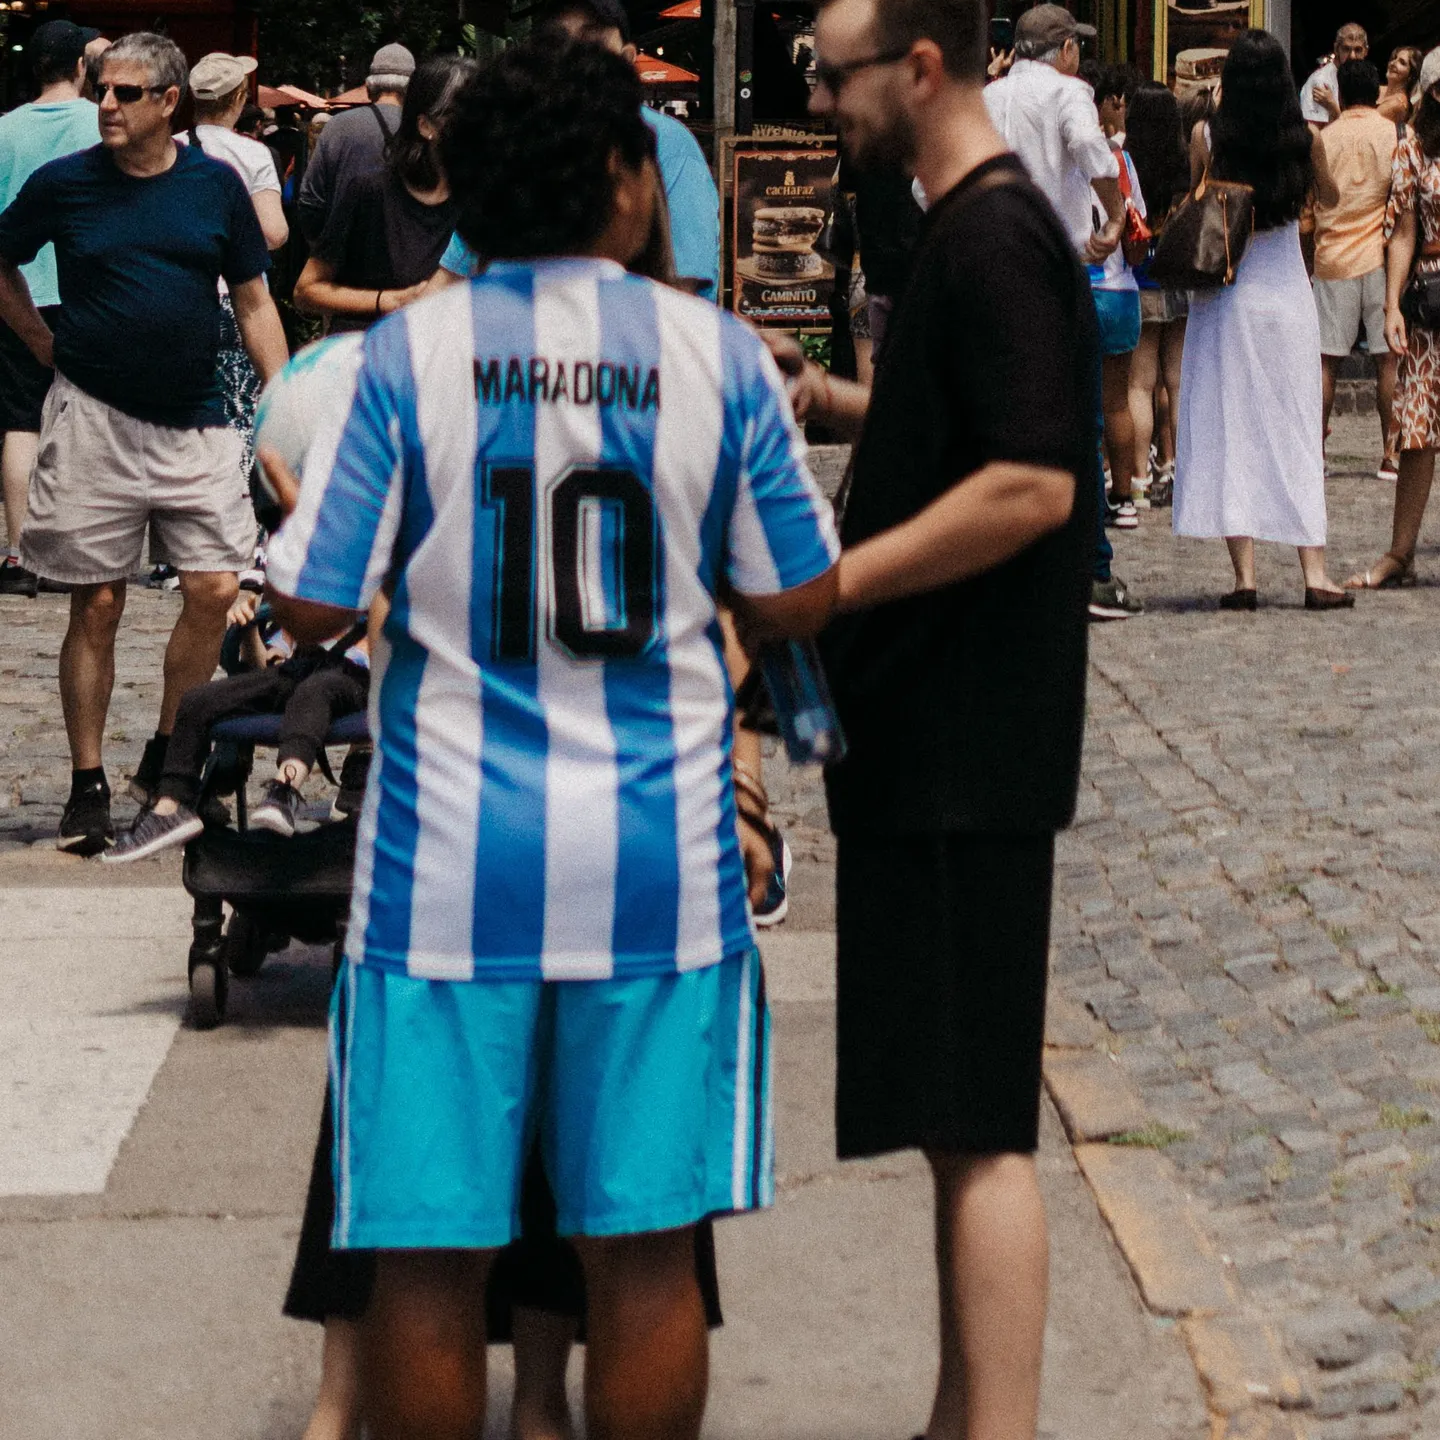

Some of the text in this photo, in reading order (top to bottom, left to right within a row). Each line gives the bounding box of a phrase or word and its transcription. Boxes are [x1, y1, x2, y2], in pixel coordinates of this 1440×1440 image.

[761, 288, 817, 303] CAMINITO
[473, 356, 660, 413] MARADONA
[481, 457, 660, 663] 10
